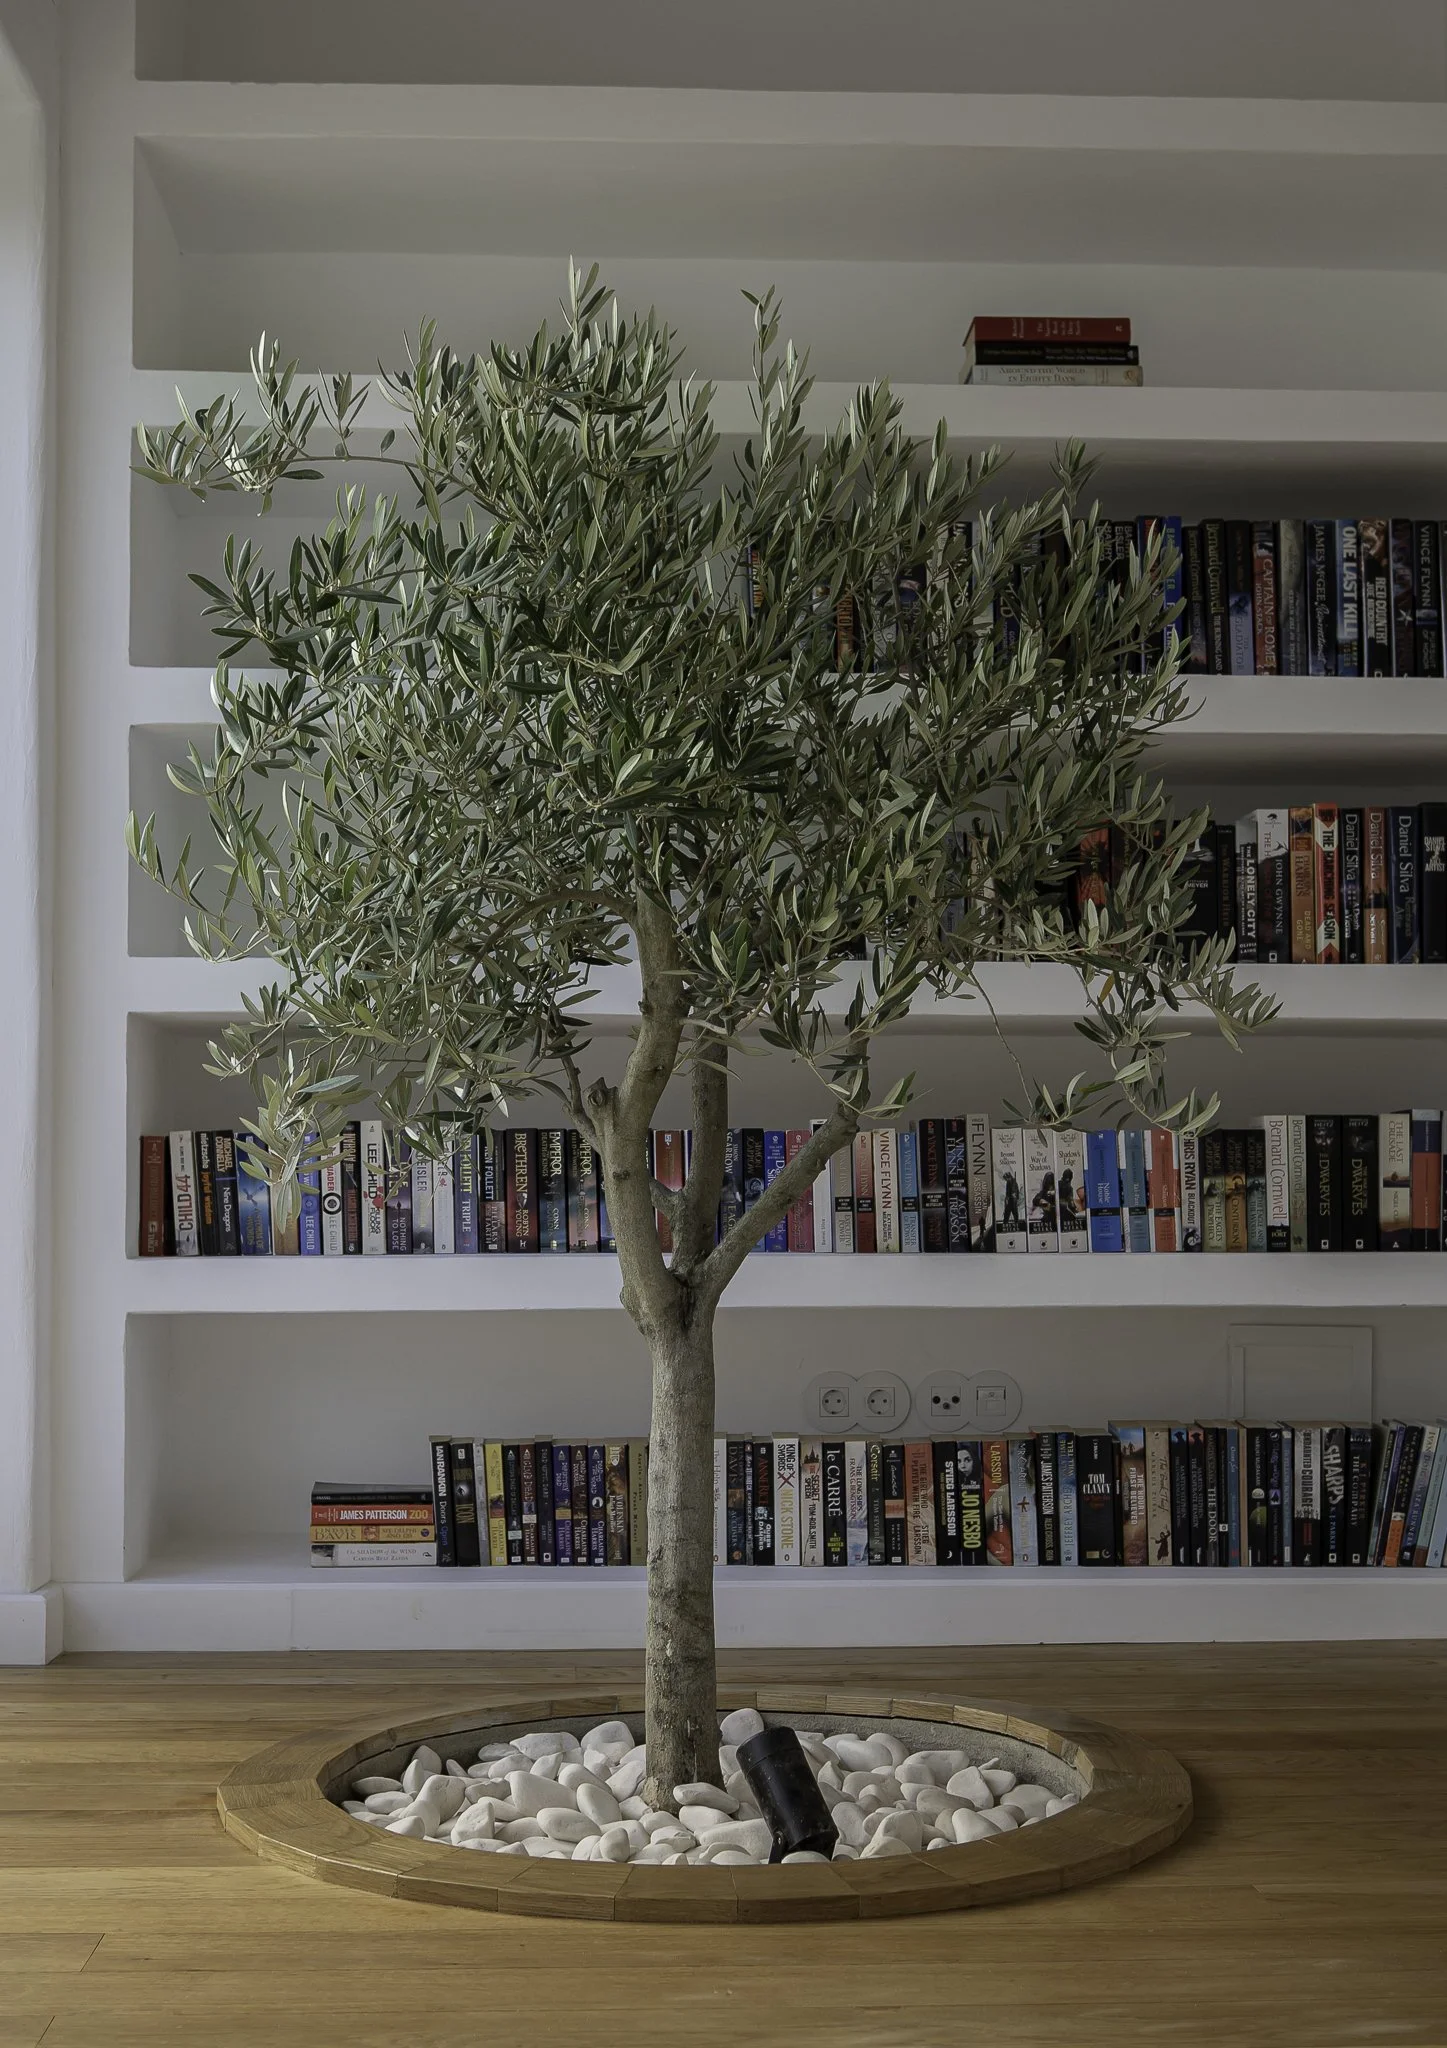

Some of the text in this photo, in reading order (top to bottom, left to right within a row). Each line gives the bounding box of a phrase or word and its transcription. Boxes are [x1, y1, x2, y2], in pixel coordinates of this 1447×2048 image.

[1314, 524, 1326, 562] JAMES
[1343, 526, 1357, 561] ONE
[1207, 524, 1224, 615] Bernard Cornwell
[1343, 562, 1358, 602] LAST
[1420, 525, 1431, 607] VINCE FLYNN
[1376, 577, 1387, 599] RED
[1263, 559, 1275, 664] CAPTAIN ROME
[1343, 603, 1358, 636] KILL
[1346, 814, 1358, 881] Daniel Silva
[1370, 812, 1383, 879] Daniel Silva
[1399, 815, 1414, 893] Daniel Silva
[1296, 855, 1304, 897] HARRIS
[1323, 829, 1336, 940] THE SEASON
[1246, 860, 1256, 939] LONELY CITY
[1274, 859, 1283, 935] JOHN GWYNNE
[215, 1136, 225, 1172] CONNELLY
[225, 1137, 233, 1171] MICHAEL
[368, 1144, 377, 1164] LEE
[549, 1131, 562, 1178] EMPEROR
[947, 1138, 956, 1175] FLYNN
[956, 1137, 965, 1176] VINCE
[972, 1123, 986, 1176] FLYNN
[1031, 1156, 1041, 1164] Way
[1292, 1120, 1305, 1194] Bernard Cornwell
[1388, 1120, 1396, 1163] CRUSADE
[417, 1161, 427, 1192] EISLER
[881, 1131, 892, 1209] VINCE FLYNN
[1029, 1164, 1051, 1172] Shadows
[1063, 1158, 1076, 1167] Edge
[1185, 1162, 1196, 1190] RYAN
[1269, 1120, 1288, 1219] Bernard Cornwell
[176, 1175, 194, 1231] CHILD 44
[485, 1166, 494, 1201] FOLLETT
[1097, 1183, 1105, 1203] House
[1319, 1159, 1331, 1217] DWARVES
[1352, 1158, 1364, 1216] DWARVES
[306, 1216, 314, 1250] LEE CHILD
[392, 1219, 399, 1230] TO
[399, 1217, 407, 1251] NOTHING
[462, 1199, 471, 1233] TRIPLE
[950, 1197, 960, 1243] TREASON
[958, 1200, 969, 1239] ACT OF
[330, 1230, 338, 1251] CHILD
[729, 1446, 739, 1484] DAVIS
[777, 1444, 786, 1472] SWORDS
[786, 1444, 796, 1471] KING OF
[870, 1445, 881, 1481] Corsair
[991, 1445, 1002, 1484] LARSSON
[1160, 1457, 1168, 1470] The
[1323, 1445, 1345, 1505] SHARPS
[436, 1445, 449, 1547] IAN RANKIN Doors Open
[811, 1474, 820, 1503] SECRET
[827, 1449, 842, 1517] le CARRÉ
[945, 1461, 957, 1536] STIEG LARSSON
[962, 1490, 980, 1507] JO
[1041, 1461, 1054, 1515] JAMES PATTERSON
[1083, 1484, 1111, 1495] CLANCY
[1088, 1474, 1105, 1485] TOM
[1302, 1469, 1314, 1508] COURAGE
[340, 1510, 429, 1520] JAMES PATTERSON ZOO
[455, 1503, 476, 1524] ICON
[616, 1494, 624, 1534] WOLFSKIN
[782, 1489, 794, 1549] NICK STONE
[1130, 1490, 1138, 1525] BELIEVED
[1208, 1486, 1217, 1543] THE DOOR
